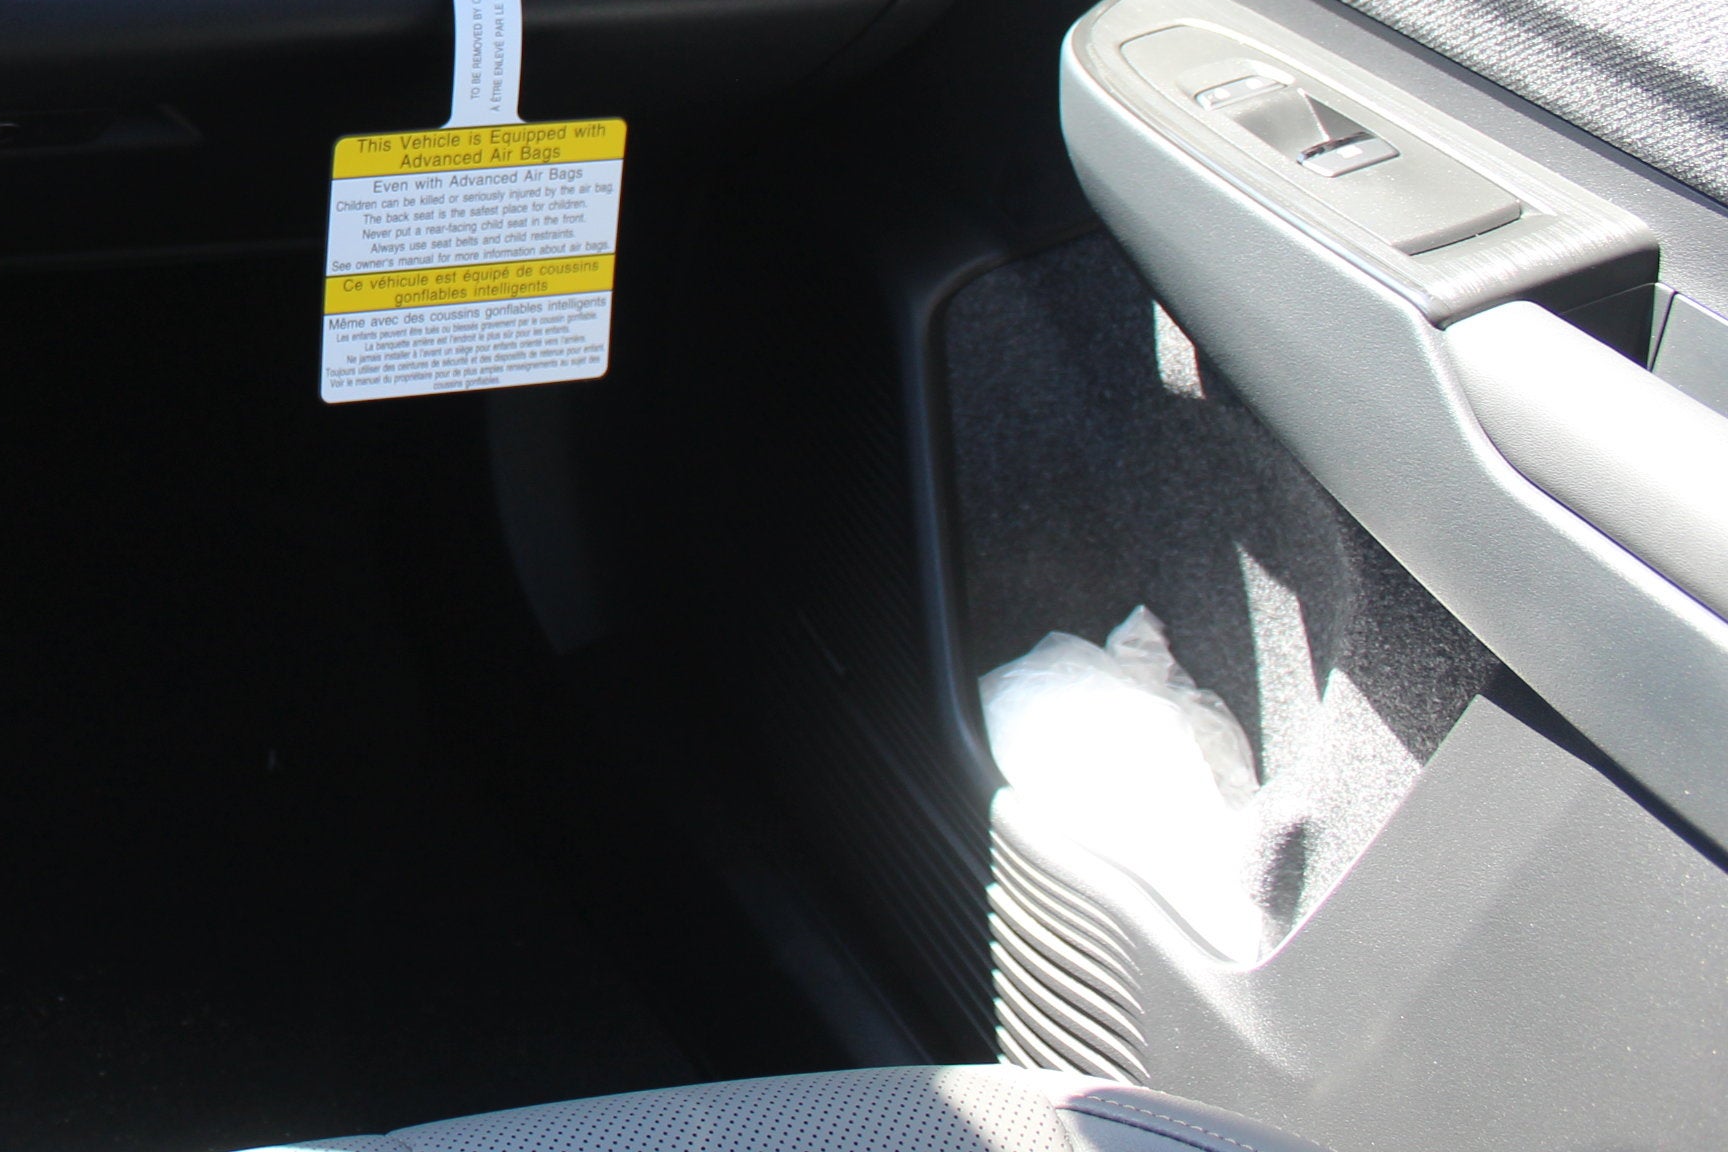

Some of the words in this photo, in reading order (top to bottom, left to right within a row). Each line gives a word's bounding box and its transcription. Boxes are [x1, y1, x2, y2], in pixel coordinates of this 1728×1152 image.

[357, 137, 391, 152] This
[400, 132, 459, 149] Vehicle
[468, 131, 480, 145] is
[490, 125, 566, 147] Equipped
[574, 122, 605, 138] with
[399, 149, 483, 168] Advanced
[490, 147, 512, 162] Air
[520, 143, 560, 163] Bags
[373, 178, 407, 193] Even
[415, 175, 442, 190] with
[449, 170, 517, 187] Advanced
[524, 168, 542, 182] Air
[549, 165, 582, 183] Bags
[364, 213, 381, 224] The
[386, 211, 408, 222] back
[414, 209, 433, 220] seat
[438, 208, 445, 218] is
[450, 206, 465, 218] the
[470, 204, 497, 216] safest
[502, 202, 527, 216] place
[532, 201, 543, 211] for
[362, 227, 391, 239] Never
[395, 225, 410, 239] put
[415, 227, 421, 235] a
[425, 220, 476, 237] rear-facing
[480, 218, 503, 230] child
[507, 216, 527, 228] seat
[531, 215, 539, 226] in
[543, 214, 558, 225] the
[332, 259, 351, 271] See
[355, 255, 393, 269] owner's
[398, 252, 433, 266] manual
[438, 251, 449, 262] for
[455, 251, 478, 261] more
[483, 244, 534, 259] information
[540, 242, 565, 254] about
[570, 241, 580, 252] air
[370, 241, 404, 256] Always
[409, 241, 426, 250] use
[431, 237, 451, 248] seat
[456, 235, 477, 246] belts
[483, 233, 500, 244] and
[504, 231, 526, 243] child
[343, 277, 362, 292] Ce
[370, 272, 428, 289] véhicule
[435, 270, 456, 284] est
[463, 265, 509, 285] équipé
[516, 263, 532, 277] de
[538, 258, 598, 275] coussins
[394, 285, 467, 306] gonflables
[474, 279, 548, 299] intelligents
[328, 316, 365, 330] Même
[370, 316, 398, 326] avec
[403, 311, 424, 324] des
[429, 307, 479, 321] coussins
[484, 301, 542, 319] gonflables
[547, 296, 605, 314] intelligents
